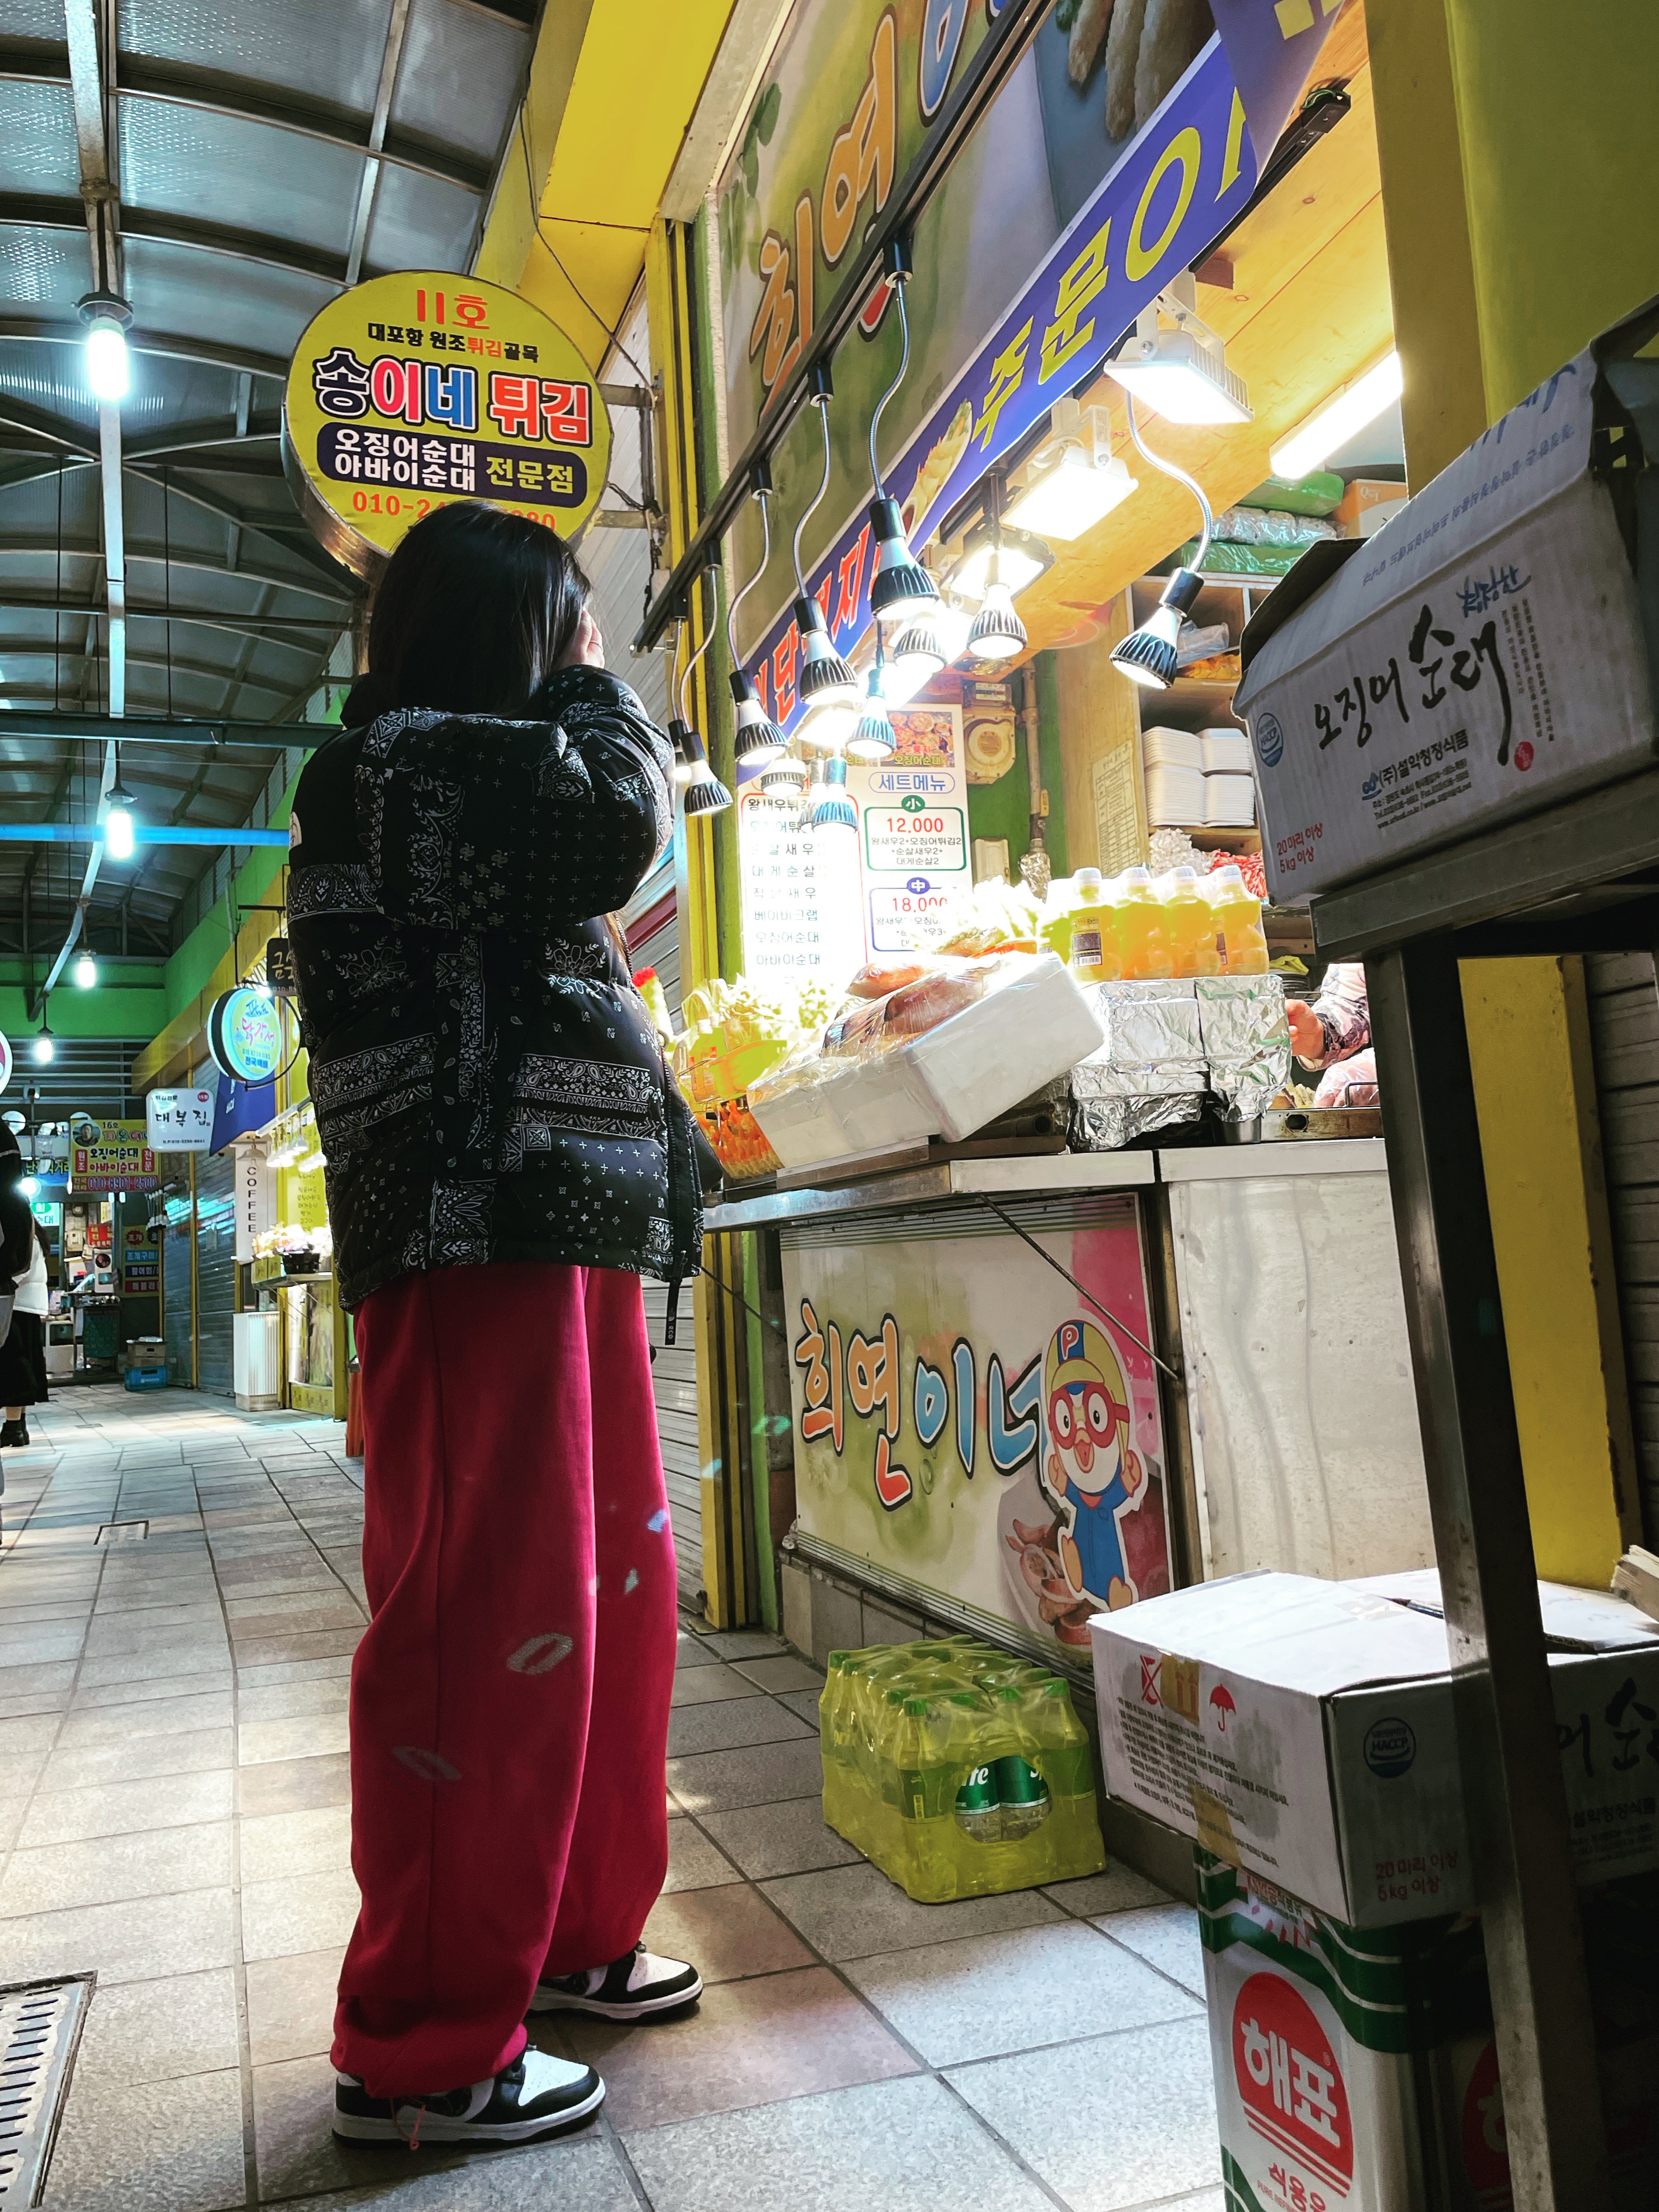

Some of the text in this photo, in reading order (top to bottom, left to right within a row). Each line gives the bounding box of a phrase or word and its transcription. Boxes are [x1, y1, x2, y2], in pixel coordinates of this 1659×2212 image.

[367, 322, 424, 347] 대포항
[313, 348, 593, 448] 송이네 튀김
[335, 429, 476, 468] 오징어순대
[335, 453, 574, 493] 아바이순대 전문점
[1259, 727, 1277, 745] HACCP
[894, 754, 942, 765] 오징어순대
[1379, 729, 1469, 788] (주)설악청정식품
[878, 774, 946, 792] 세트메뉴
[905, 798, 921, 810] 小
[887, 817, 944, 833] 12.000
[1306, 823, 1323, 840] 이상
[1297, 846, 1314, 864] 이상
[911, 879, 925, 892] 中
[754, 909, 818, 922] 베이비크랩
[756, 932, 819, 944] 오징어순대
[757, 953, 820, 966] 아바이순대
[90, 1148, 139, 1160] 오징어순대
[90, 1162, 139, 1174] 아바이순대
[247, 1166, 257, 1233] COFFEE
[1372, 1736, 1409, 1752] HACCP
[1430, 1851, 1458, 1870] 이상
[1412, 1876, 1440, 1894] 이상
[1240, 2017, 1341, 2149] 해표
